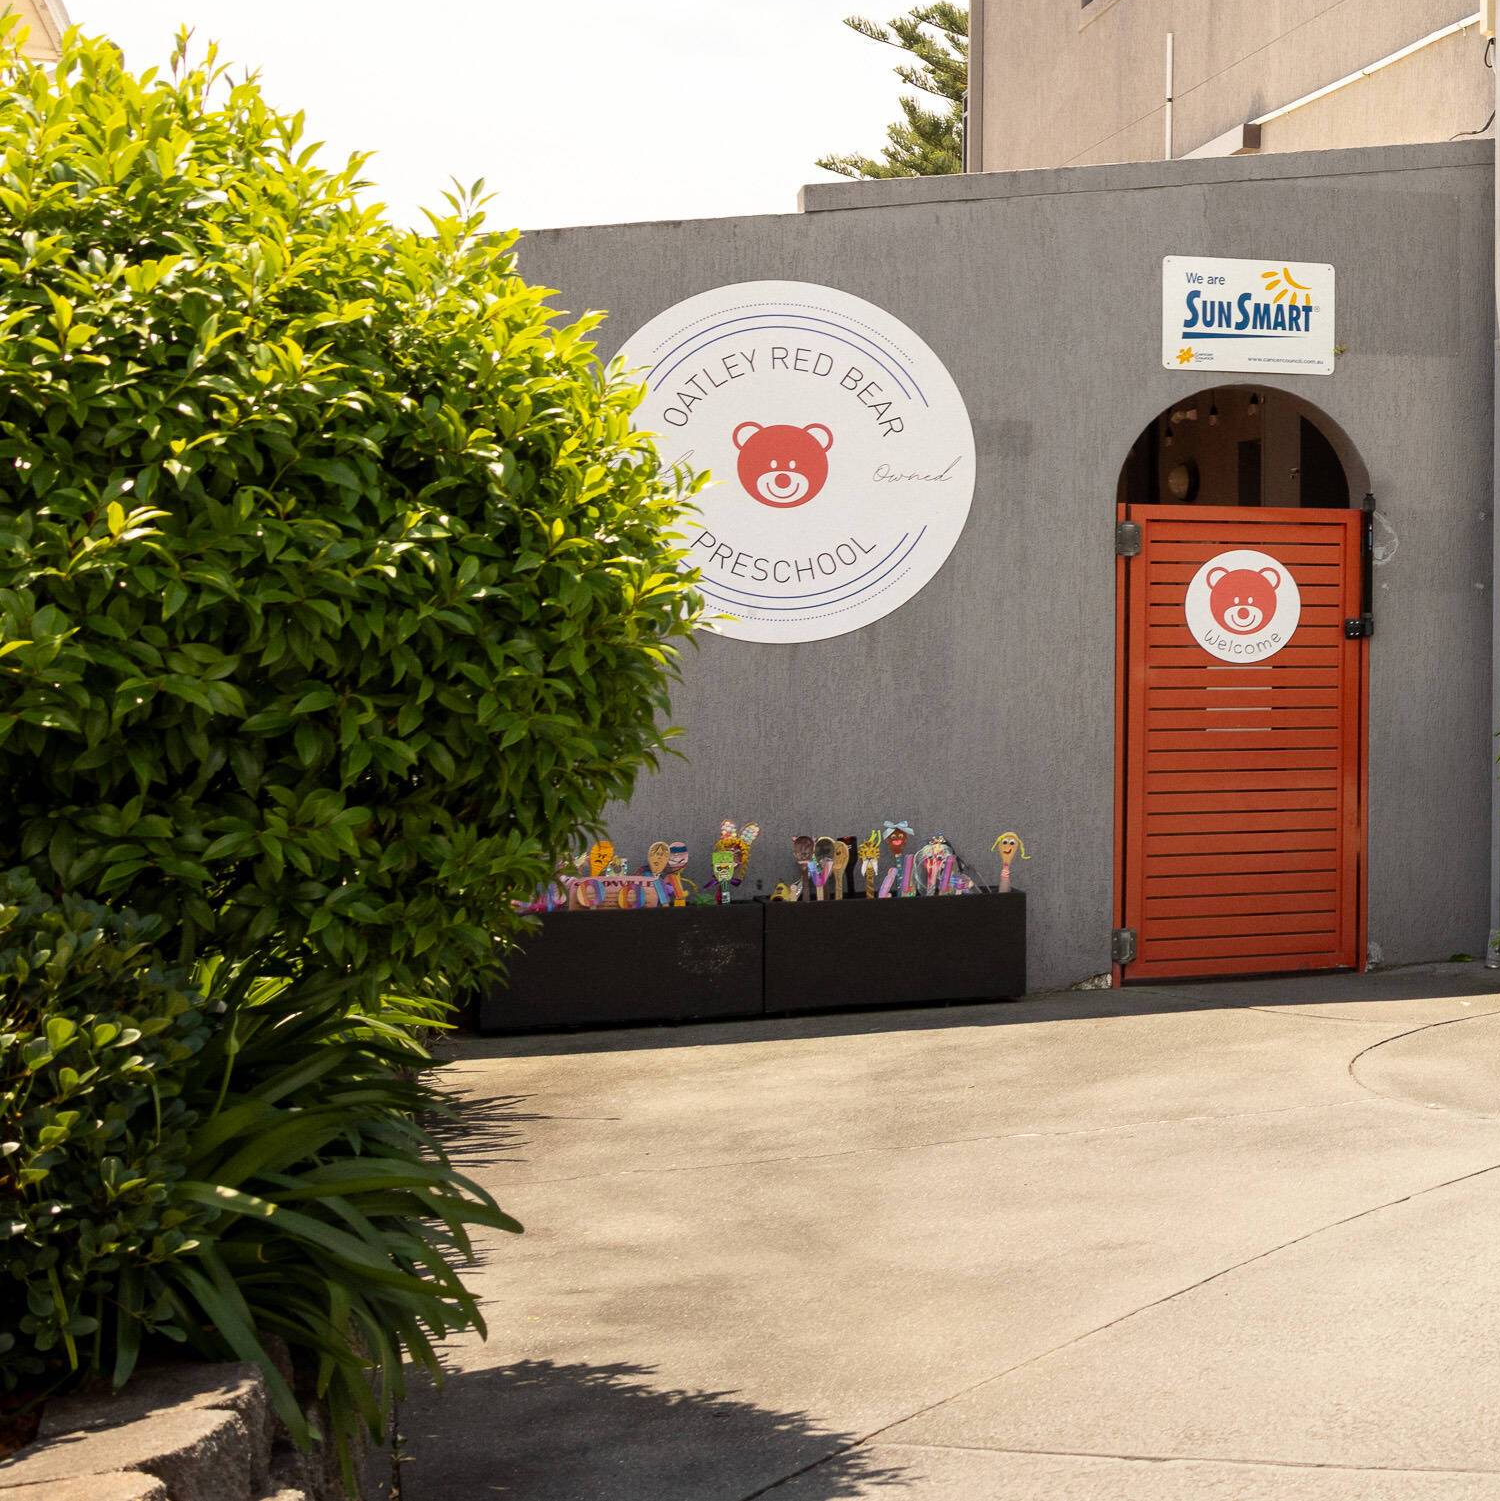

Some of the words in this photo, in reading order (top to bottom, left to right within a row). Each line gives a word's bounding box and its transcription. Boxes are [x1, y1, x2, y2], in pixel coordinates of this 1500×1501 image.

[1185, 271, 1205, 286] We
[1207, 275, 1226, 286] are
[662, 347, 757, 428] OATLEY
[771, 346, 834, 378] RED
[839, 366, 905, 438] BEAR
[872, 455, 962, 483] Owned
[689, 530, 877, 584] PRESCHOOL
[1204, 628, 1282, 655] Welcome
